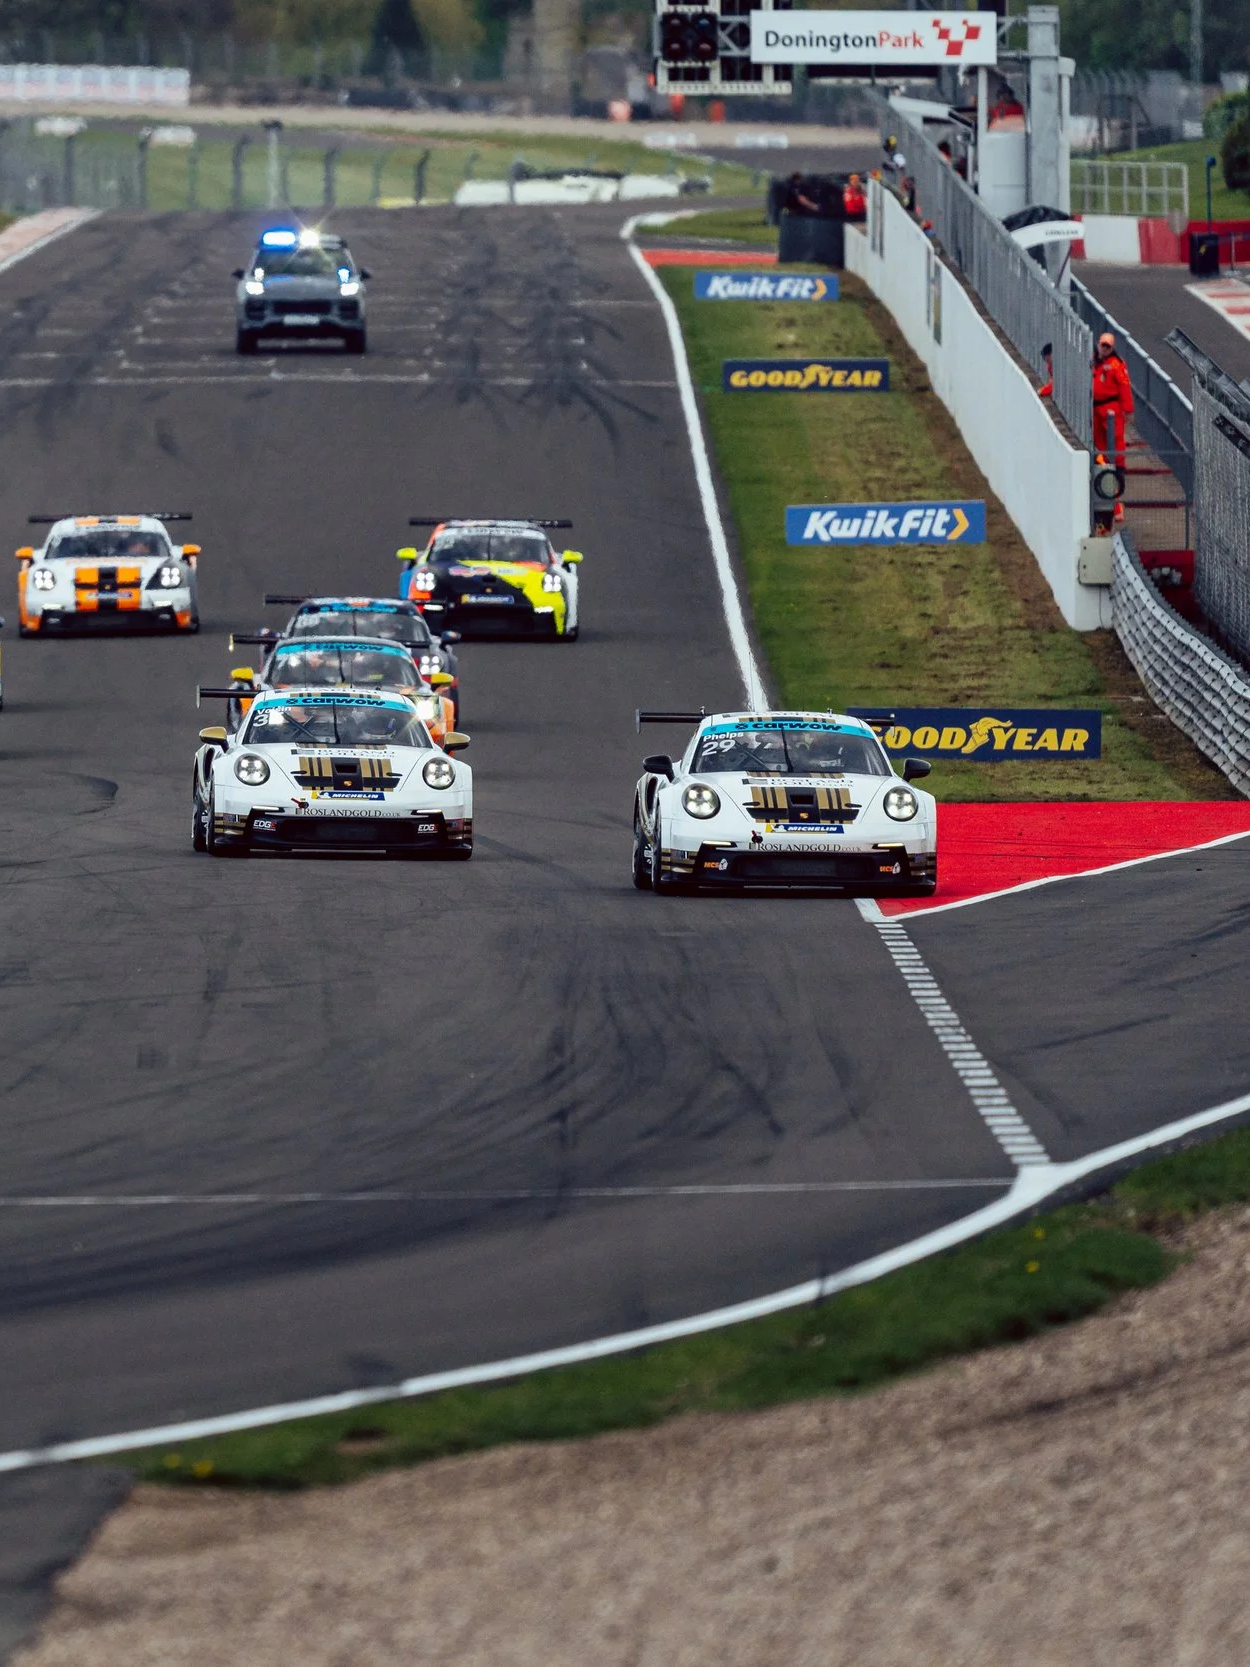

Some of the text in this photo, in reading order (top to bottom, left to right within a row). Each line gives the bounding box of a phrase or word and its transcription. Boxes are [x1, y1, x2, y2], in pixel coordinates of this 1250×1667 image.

[729, 366, 882, 387] GOODYEAR
[301, 696, 386, 706] carwow
[752, 721, 843, 731] carwow
[703, 731, 744, 742] Phelps
[701, 739, 736, 757] 29
